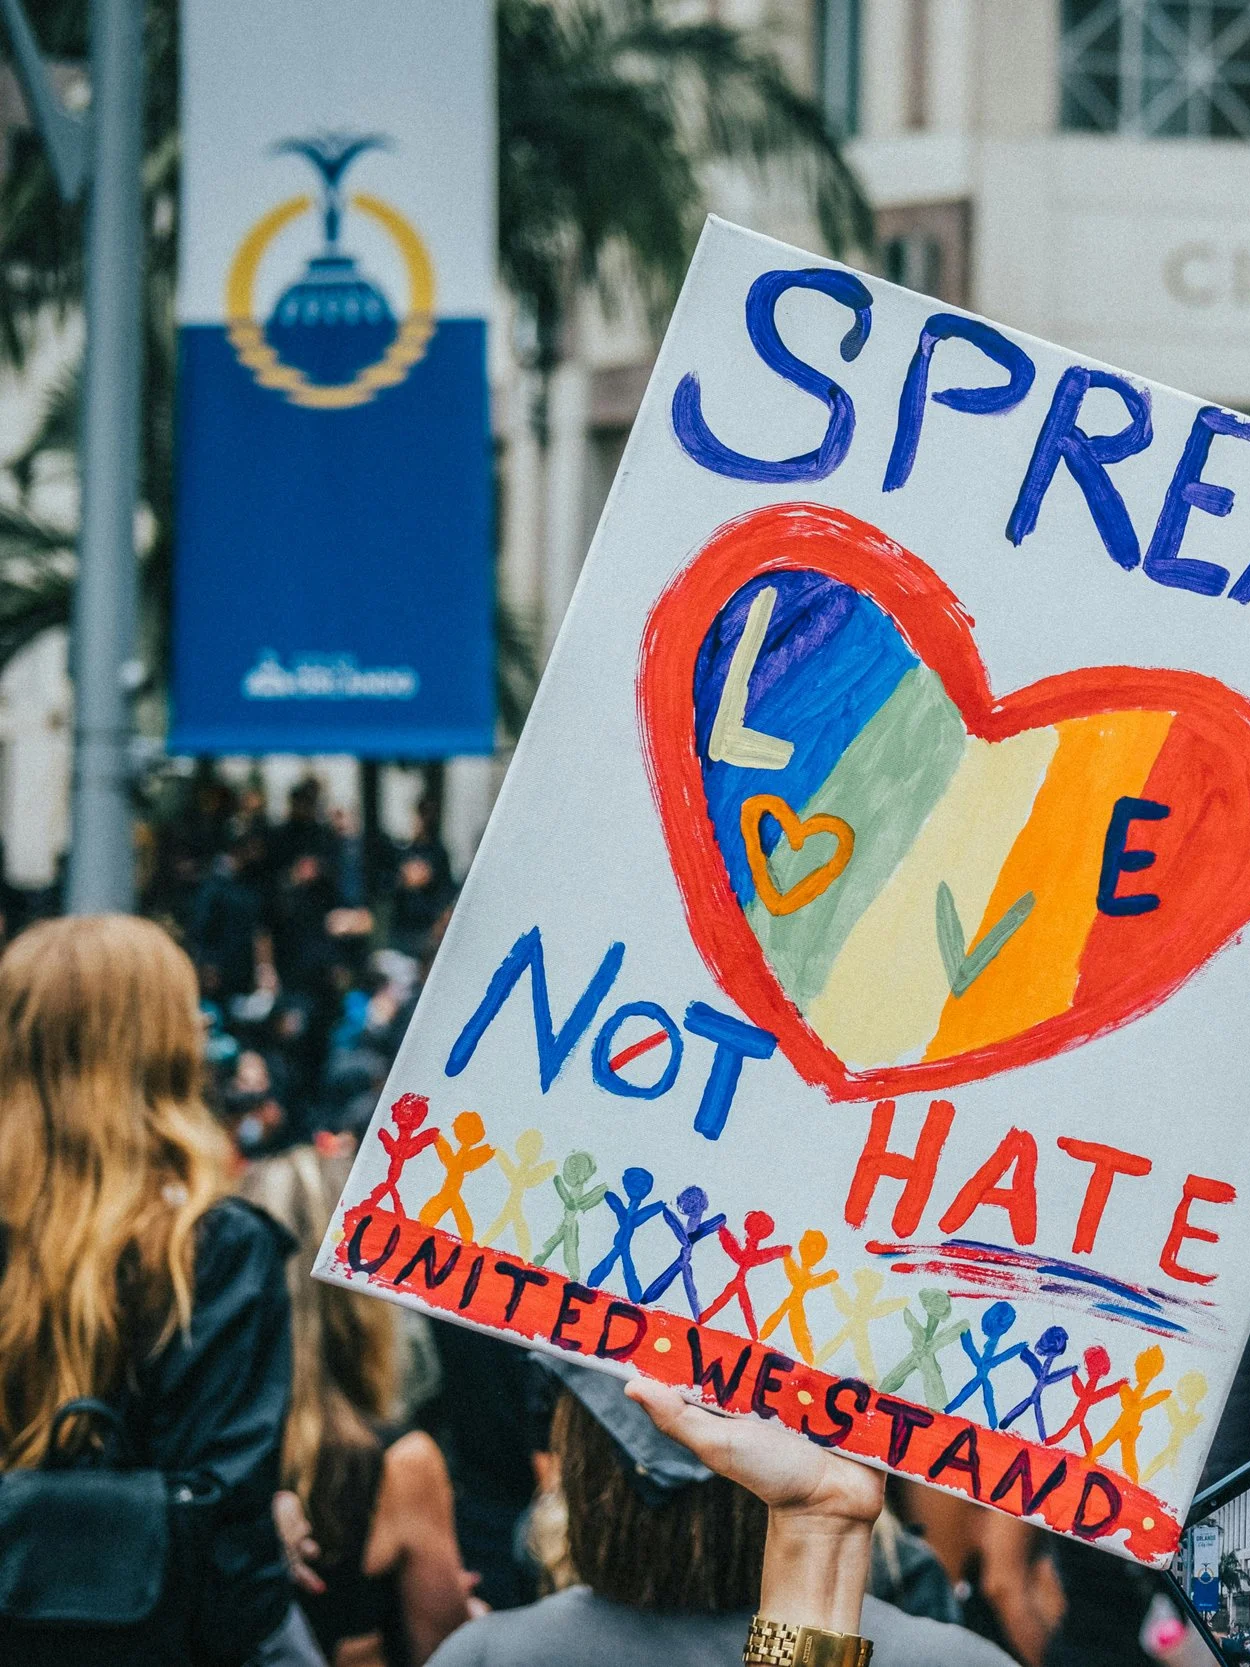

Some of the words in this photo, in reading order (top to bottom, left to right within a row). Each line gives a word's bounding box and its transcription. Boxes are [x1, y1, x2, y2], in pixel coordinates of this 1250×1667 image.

[444, 925, 779, 1141] NOT
[844, 1099, 1237, 1286] HATE
[348, 1214, 648, 1359] UNITED
[686, 1326, 794, 1420] WE
[800, 1378, 1123, 1537] STAND
